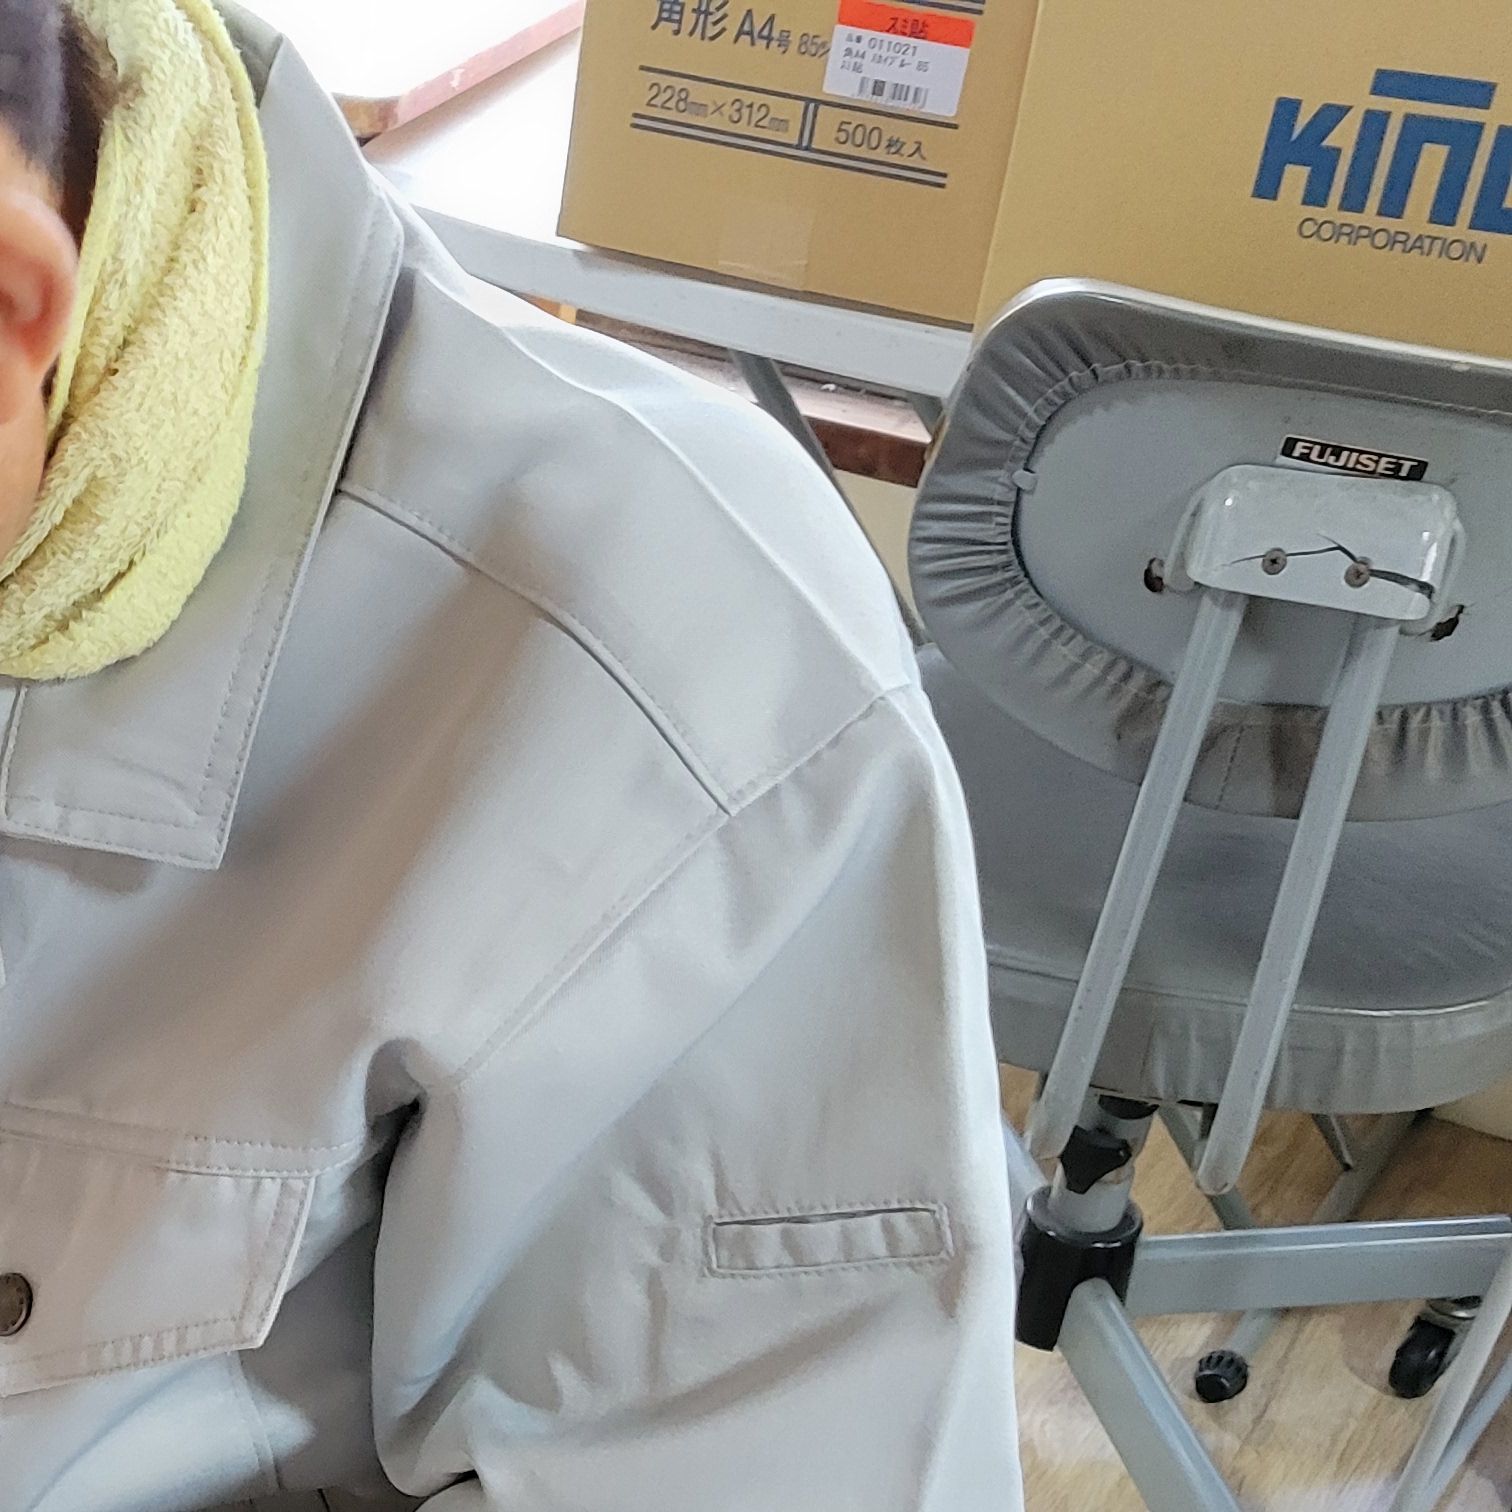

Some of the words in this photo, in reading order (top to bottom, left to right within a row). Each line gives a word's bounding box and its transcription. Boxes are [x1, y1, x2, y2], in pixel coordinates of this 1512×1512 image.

[651, 0, 729, 42] 角形
[734, 9, 792, 54] A4号
[867, 37, 918, 57] 011021
[834, 120, 926, 161] 500枚入
[1297, 217, 1487, 264] CORPORATION
[1292, 441, 1419, 477] FUJISET
